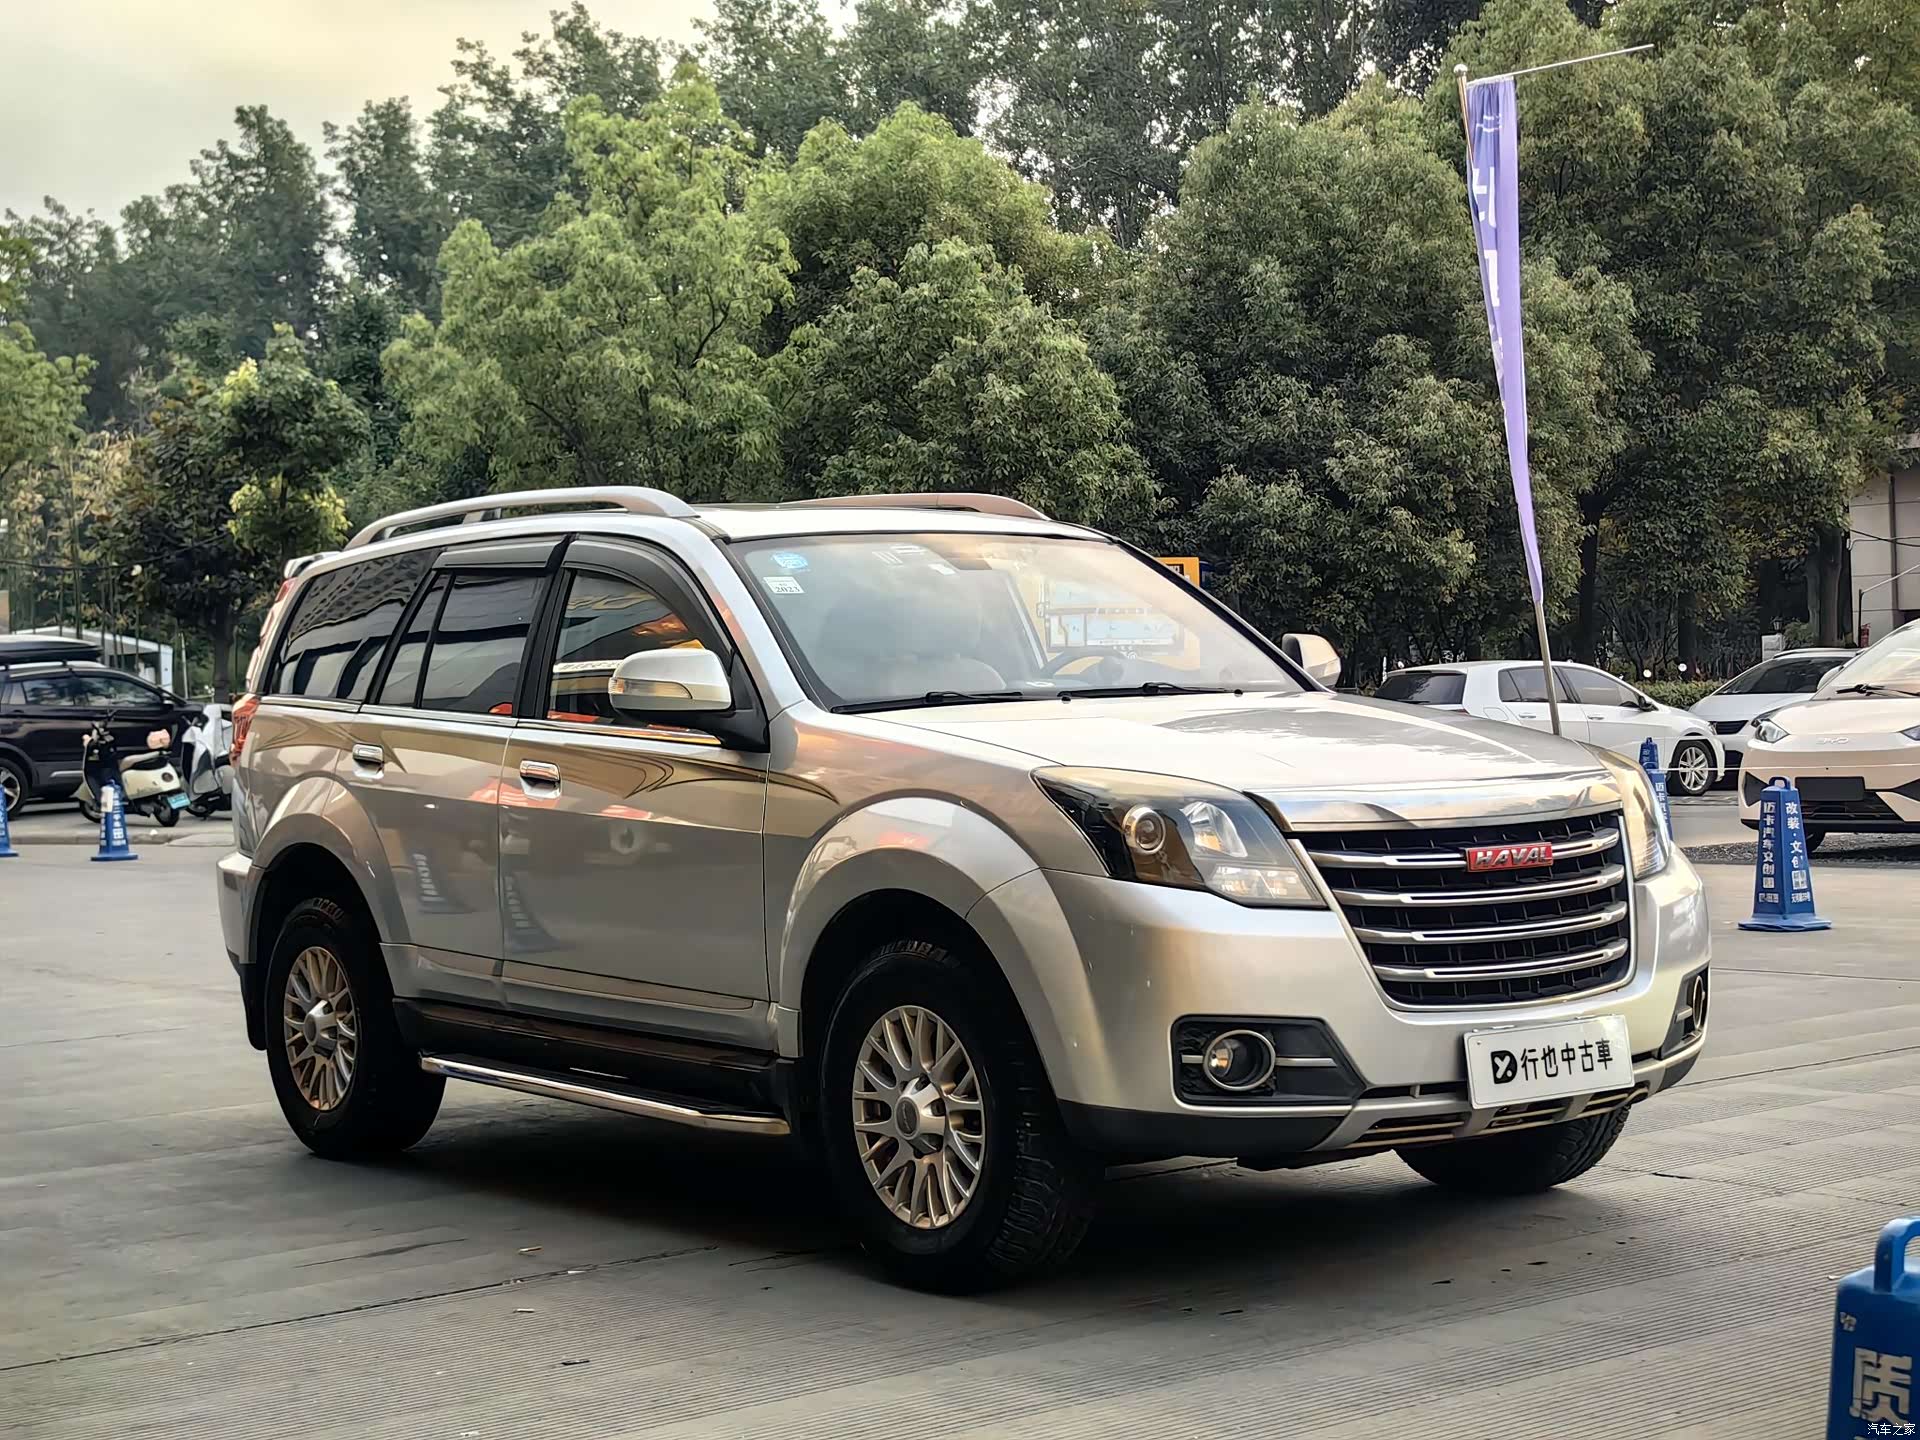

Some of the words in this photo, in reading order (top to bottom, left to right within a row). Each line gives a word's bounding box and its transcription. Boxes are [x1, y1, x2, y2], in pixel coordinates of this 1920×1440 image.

[1475, 846, 1552, 865] HAVAL
[1520, 1038, 1613, 1081] 行也中古車
